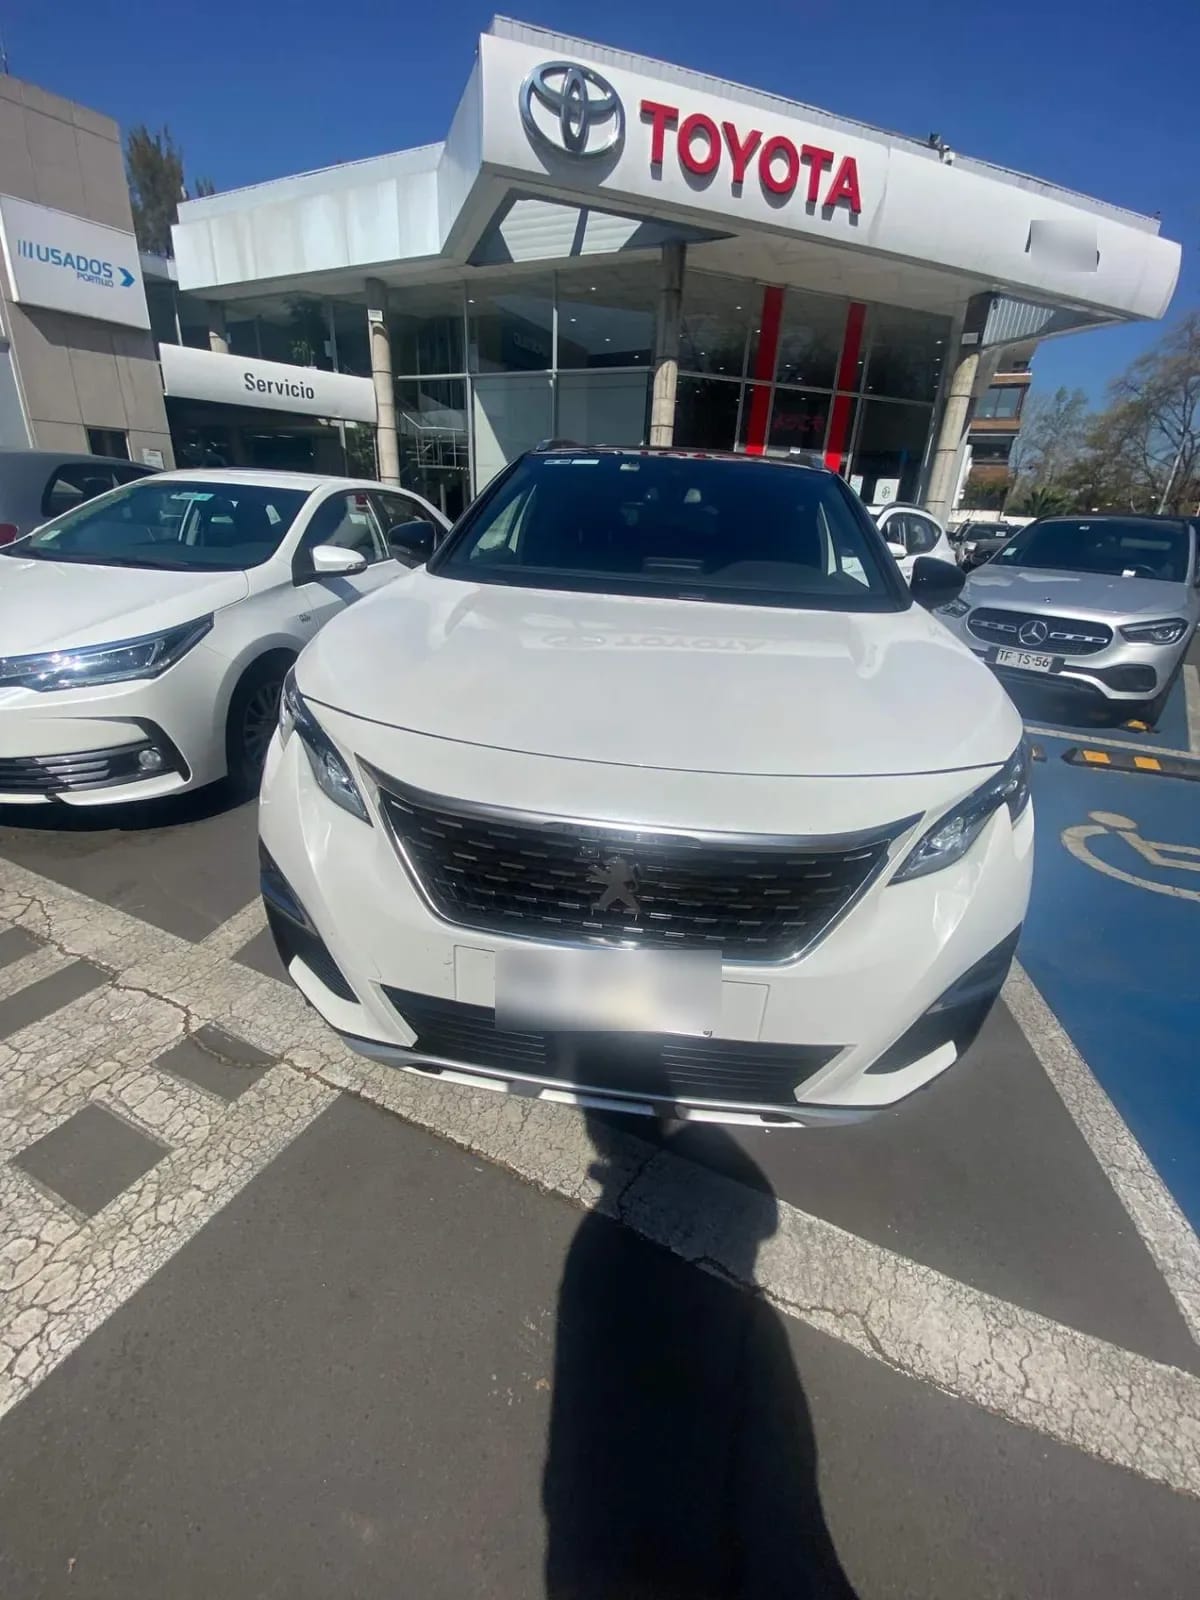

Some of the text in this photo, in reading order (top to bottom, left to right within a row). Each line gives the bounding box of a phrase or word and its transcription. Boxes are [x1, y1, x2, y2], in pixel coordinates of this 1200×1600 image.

[640, 99, 862, 214] TOYOTA
[36, 244, 113, 279] USADOS
[244, 372, 314, 399] Servicio
